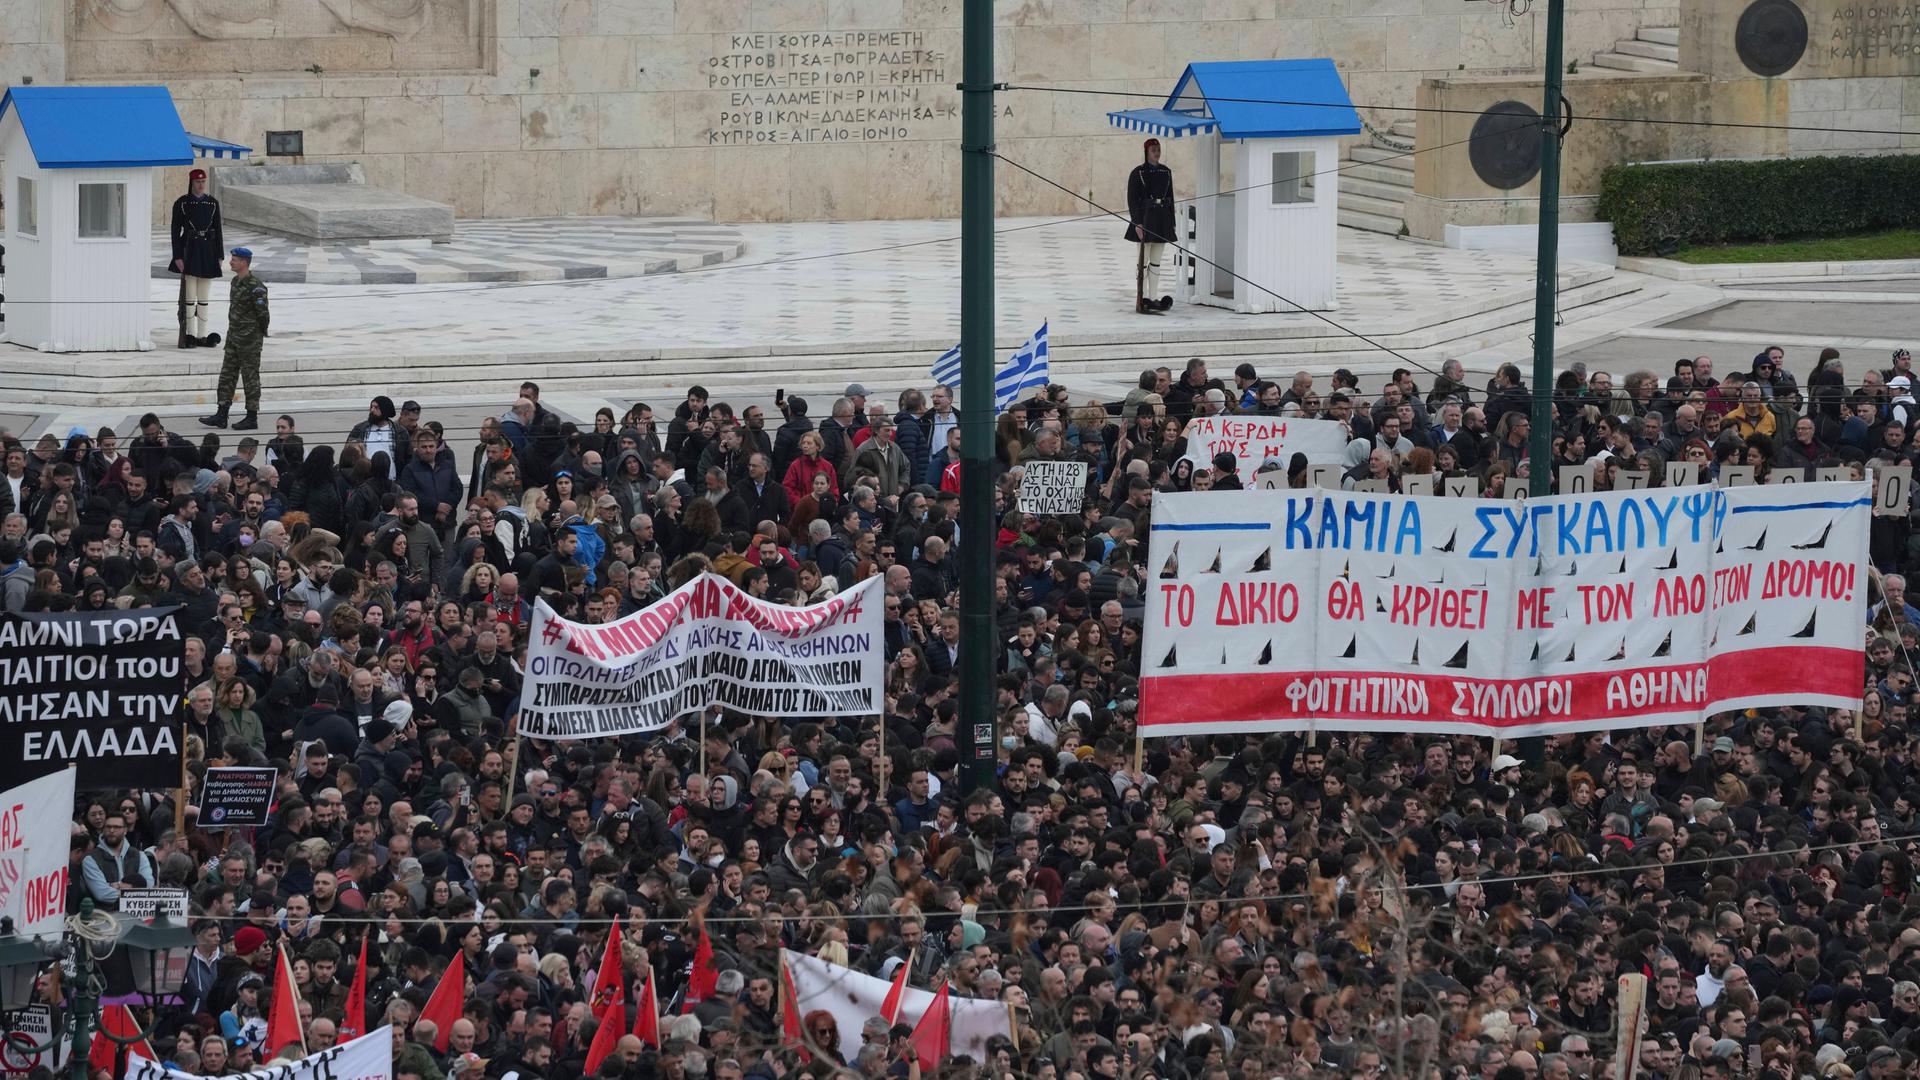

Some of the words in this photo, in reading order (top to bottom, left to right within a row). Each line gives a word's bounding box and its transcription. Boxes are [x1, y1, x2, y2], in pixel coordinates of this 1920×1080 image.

[1197, 419, 1214, 435] ΤΑ
[1222, 419, 1287, 439] ΚΕΡΔΗ
[1022, 476, 1039, 486] ΑΣ
[1042, 476, 1075, 486] ΕΙΝΑΙ
[1025, 463, 1055, 475] ΑΥΤΗ
[1059, 464, 1065, 475] Η
[1021, 498, 1063, 513] ΓΕΝΙΑΣ
[1065, 497, 1081, 512] ΜΑΣ
[1025, 486, 1040, 497] ΤΟ
[1046, 487, 1066, 498] ΟΧΙ
[1069, 487, 1085, 498] ΤΗΣ
[1286, 497, 1422, 555] ΚΑΜΙΑ
[690, 578, 720, 626] ΝΑ
[1160, 583, 1195, 627] ΤΟ
[1216, 582, 1299, 626] ΔΙΚΙΟ
[1327, 580, 1365, 621] ΘΑ
[1390, 585, 1488, 629] ΚΡΙΘΕΙ
[1517, 587, 1555, 630] ΜΕ
[1577, 582, 1634, 624] ΤΟΝ
[1653, 574, 1706, 617] ΛΑΟ
[1712, 563, 1752, 611] ΣΤΟΝ
[1761, 559, 1855, 602] ΔΡΟΜΟ!
[91, 615, 181, 646] ΤΩΡΑ
[115, 657, 179, 679] που
[532, 656, 549, 675] ΟΙ
[553, 656, 640, 684] ΠΩΛΗΤΕΣ
[791, 632, 870, 658] ΑΘΗΝΩΝ
[675, 656, 698, 688] ΣΤΟΝ
[750, 658, 797, 683] ΑΓΩΝΑ
[809, 660, 861, 686] ΓΟΝΕΩΝ
[1285, 677, 1428, 715] ΦΟΙΤΗΤΙΚΟΙ
[1452, 679, 1572, 719] ΣΥΛΛΟΓΟΙ
[1607, 665, 1709, 710] ΑΘΗΝΑ
[118, 694, 179, 723] την
[519, 708, 544, 731] ΓΙΑ
[547, 710, 596, 735] ΑΜΕΣΗ
[684, 683, 707, 709] ΤΟΥ
[802, 689, 827, 711] ΤΩΝ
[824, 688, 872, 711] ΤΕΜΠΩΝ
[23, 726, 177, 761] ΕΛΛΑΔΑ
[126, 901, 181, 909] ΚΥΒΕΡΣΗ
